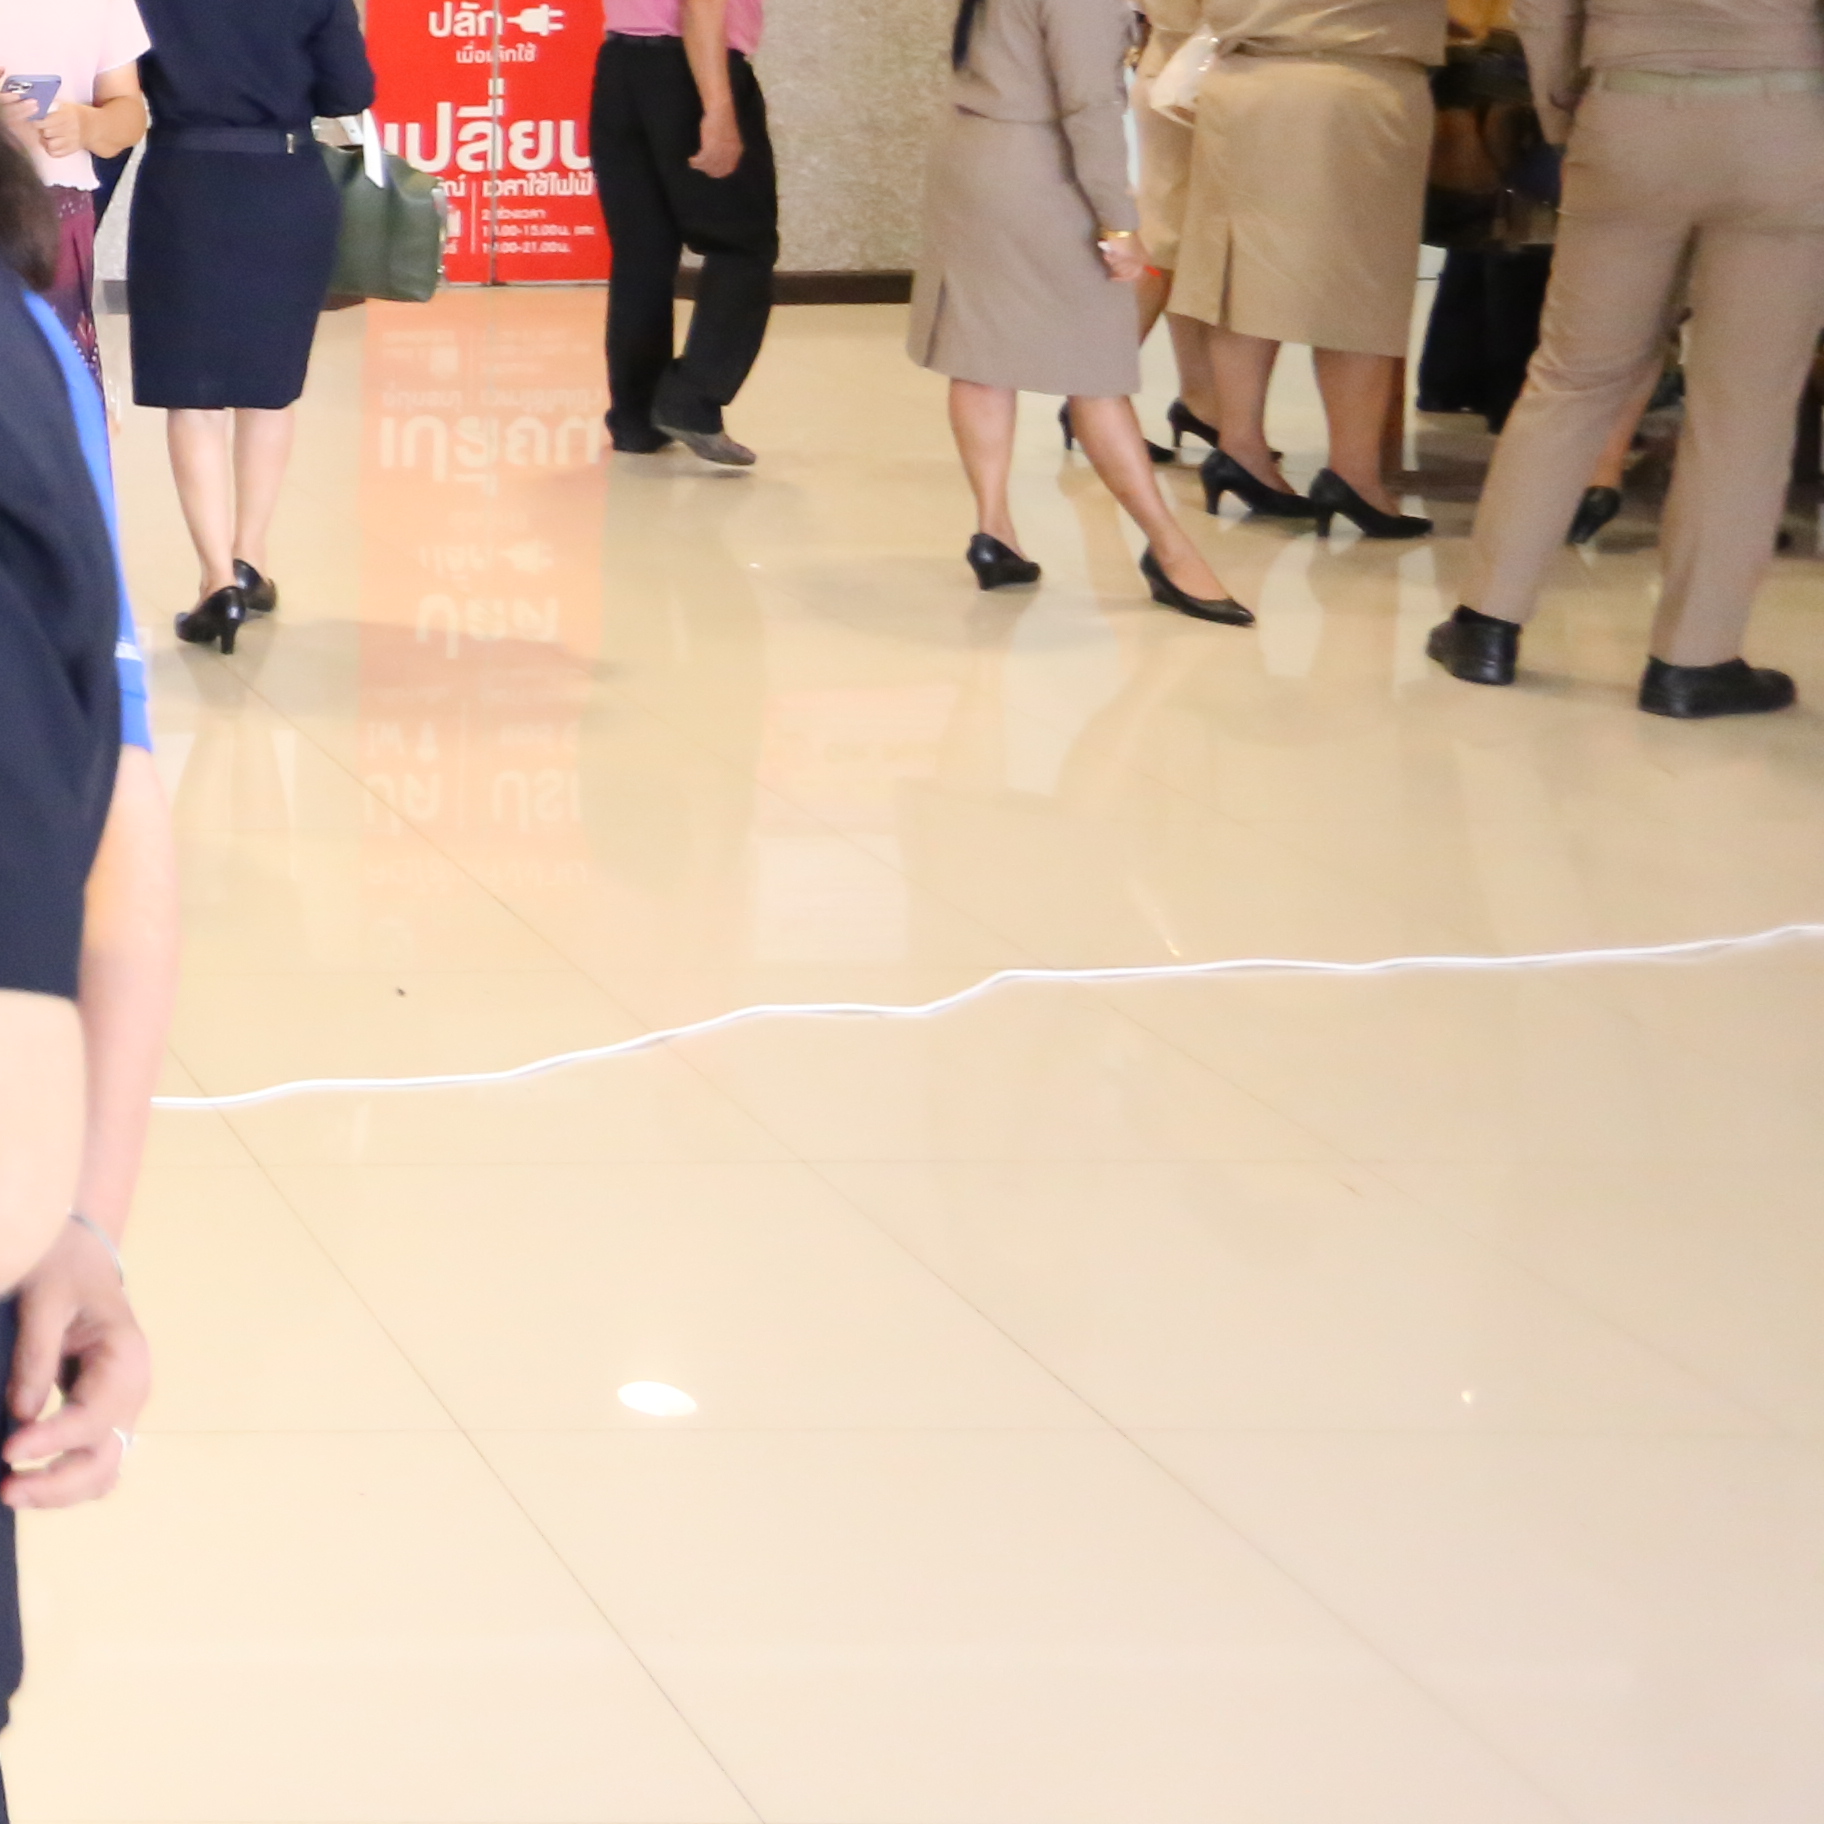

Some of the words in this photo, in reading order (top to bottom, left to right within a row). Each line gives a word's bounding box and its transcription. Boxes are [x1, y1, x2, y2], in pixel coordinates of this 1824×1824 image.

[482, 171, 596, 197] เวลาใช้ไฟฟ้
